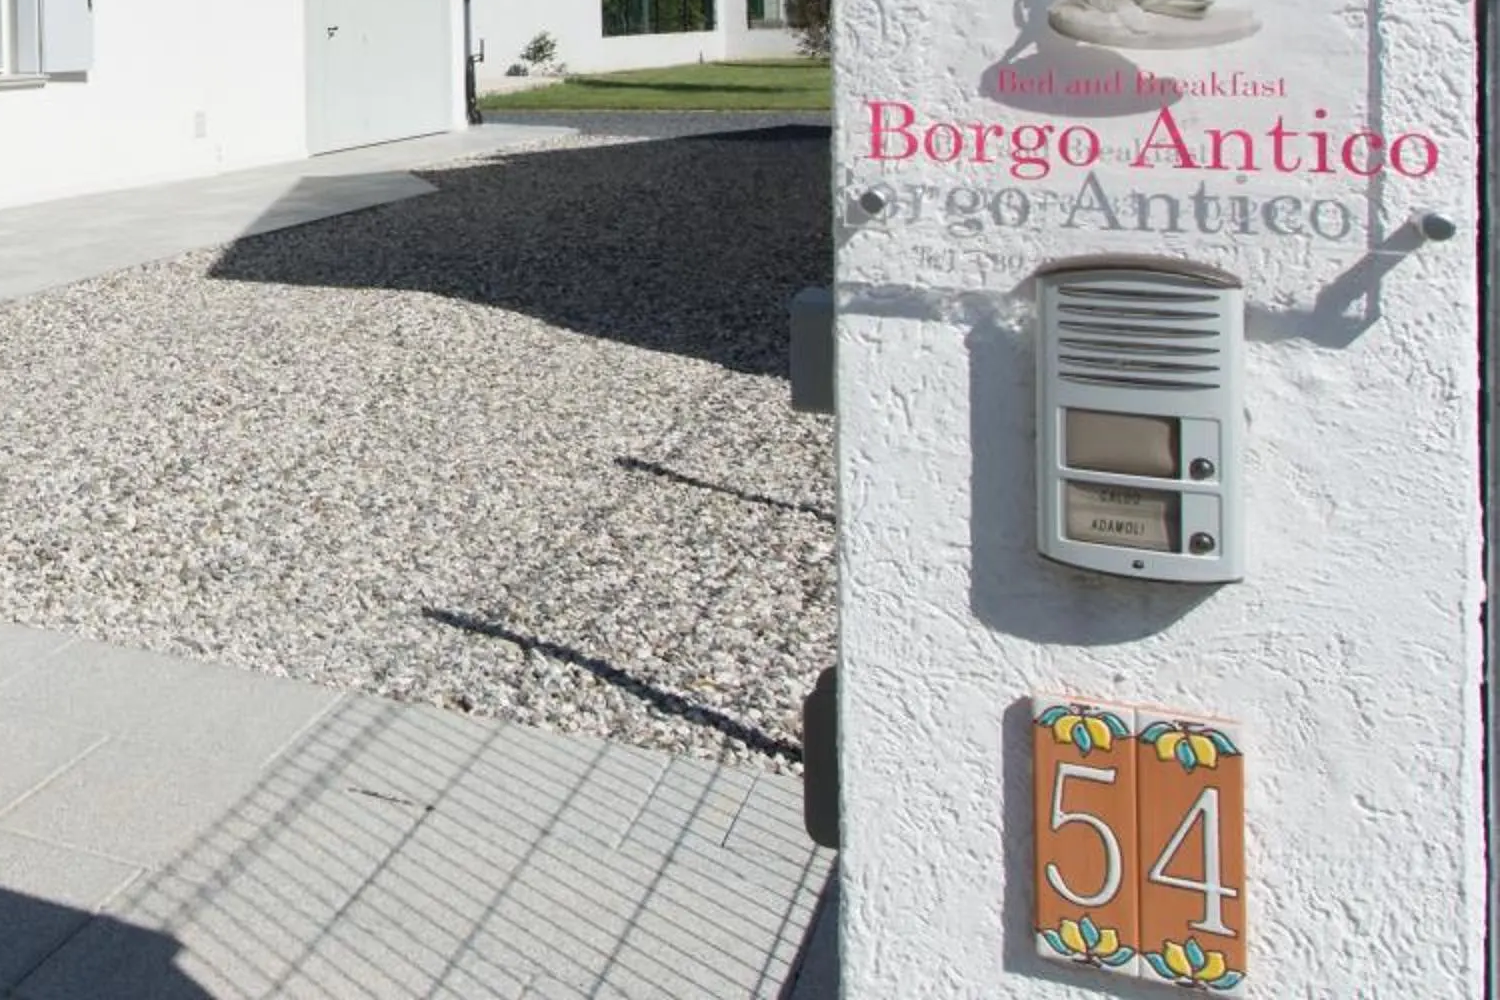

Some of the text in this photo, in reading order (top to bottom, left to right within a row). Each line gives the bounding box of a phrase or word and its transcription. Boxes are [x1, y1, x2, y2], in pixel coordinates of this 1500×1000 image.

[997, 69, 1286, 98] Bed and Breakfast
[862, 99, 1439, 180] Borgo Antico
[1091, 519, 1145, 537] ADAMOLI
[1045, 762, 1238, 938] 54
